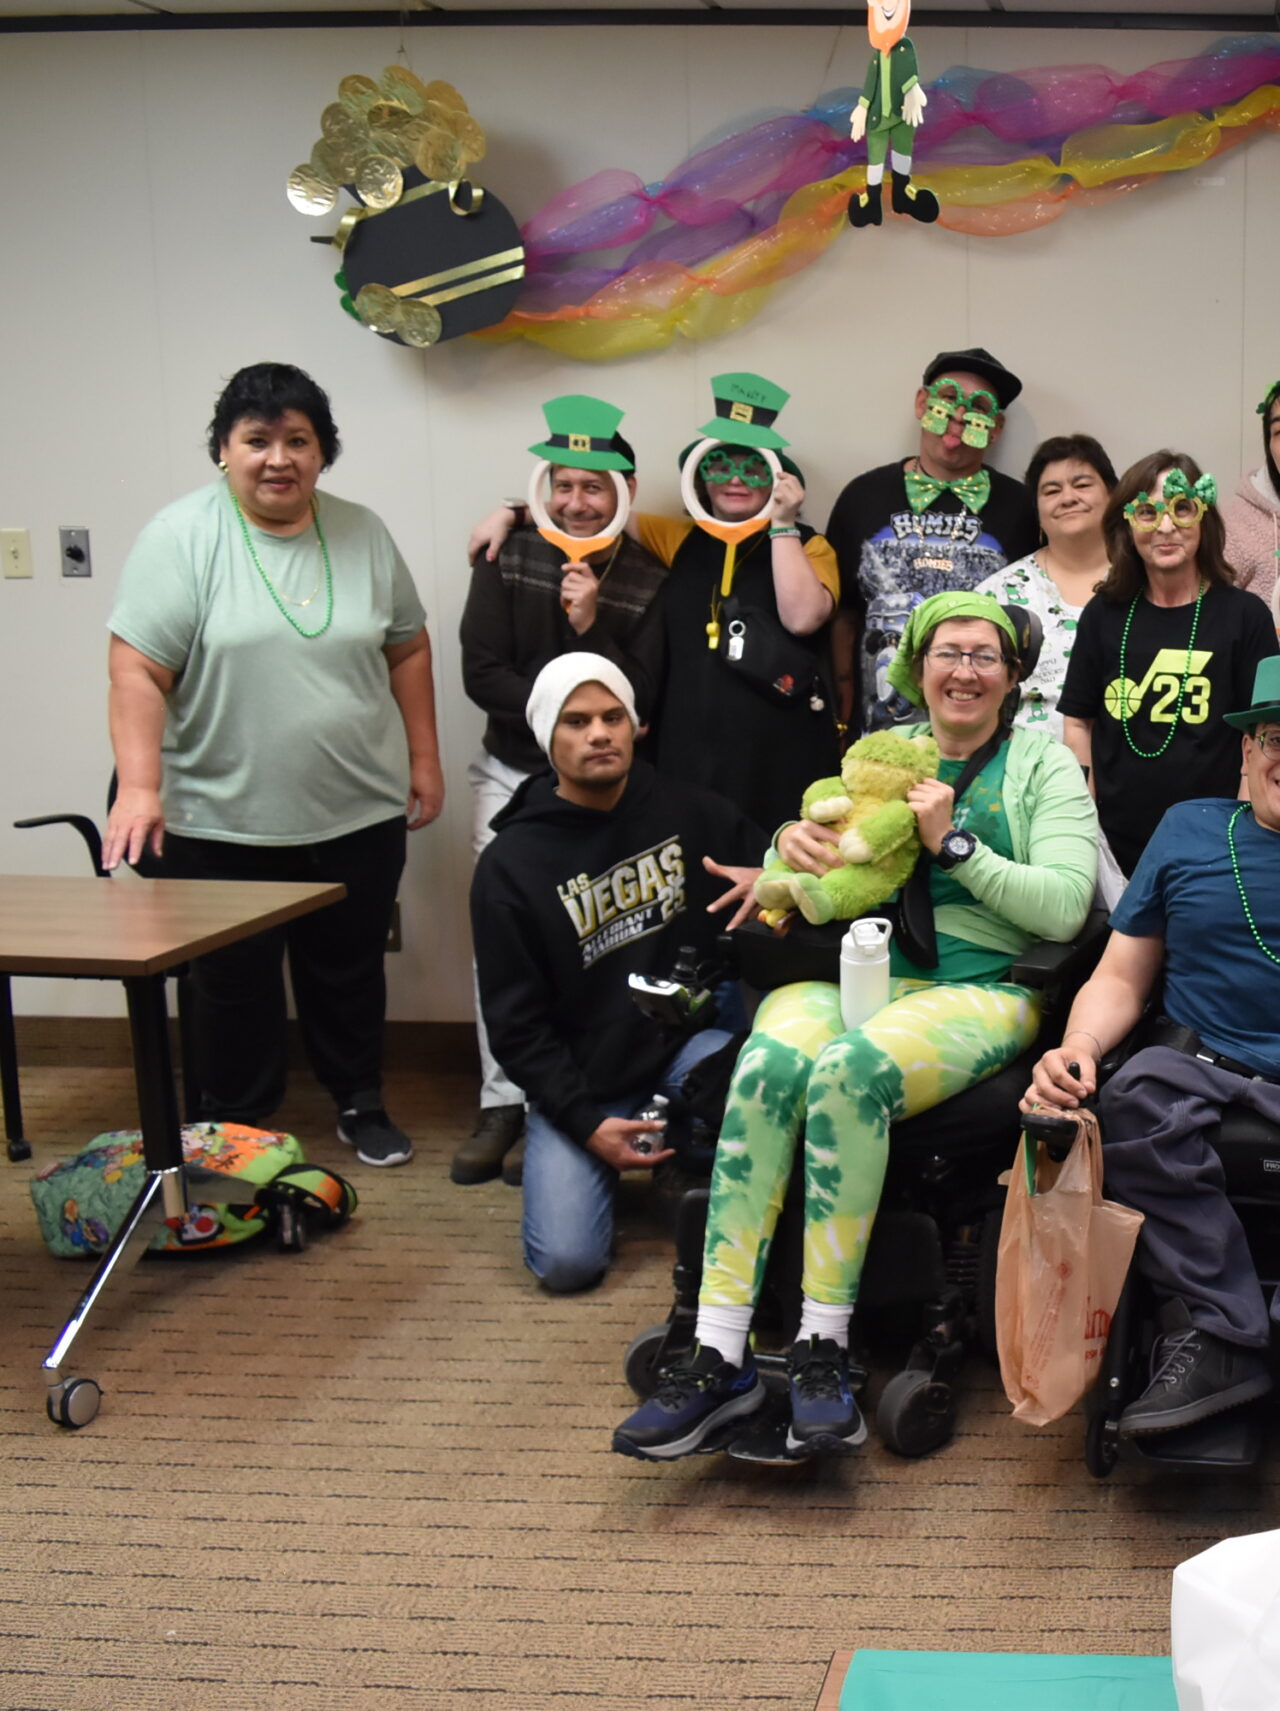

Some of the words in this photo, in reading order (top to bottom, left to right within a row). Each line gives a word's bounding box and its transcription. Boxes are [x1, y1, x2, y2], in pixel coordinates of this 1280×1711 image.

[1150, 674, 1212, 724] 23
[556, 872, 590, 901] LAS
[563, 843, 686, 939] VEGAS
